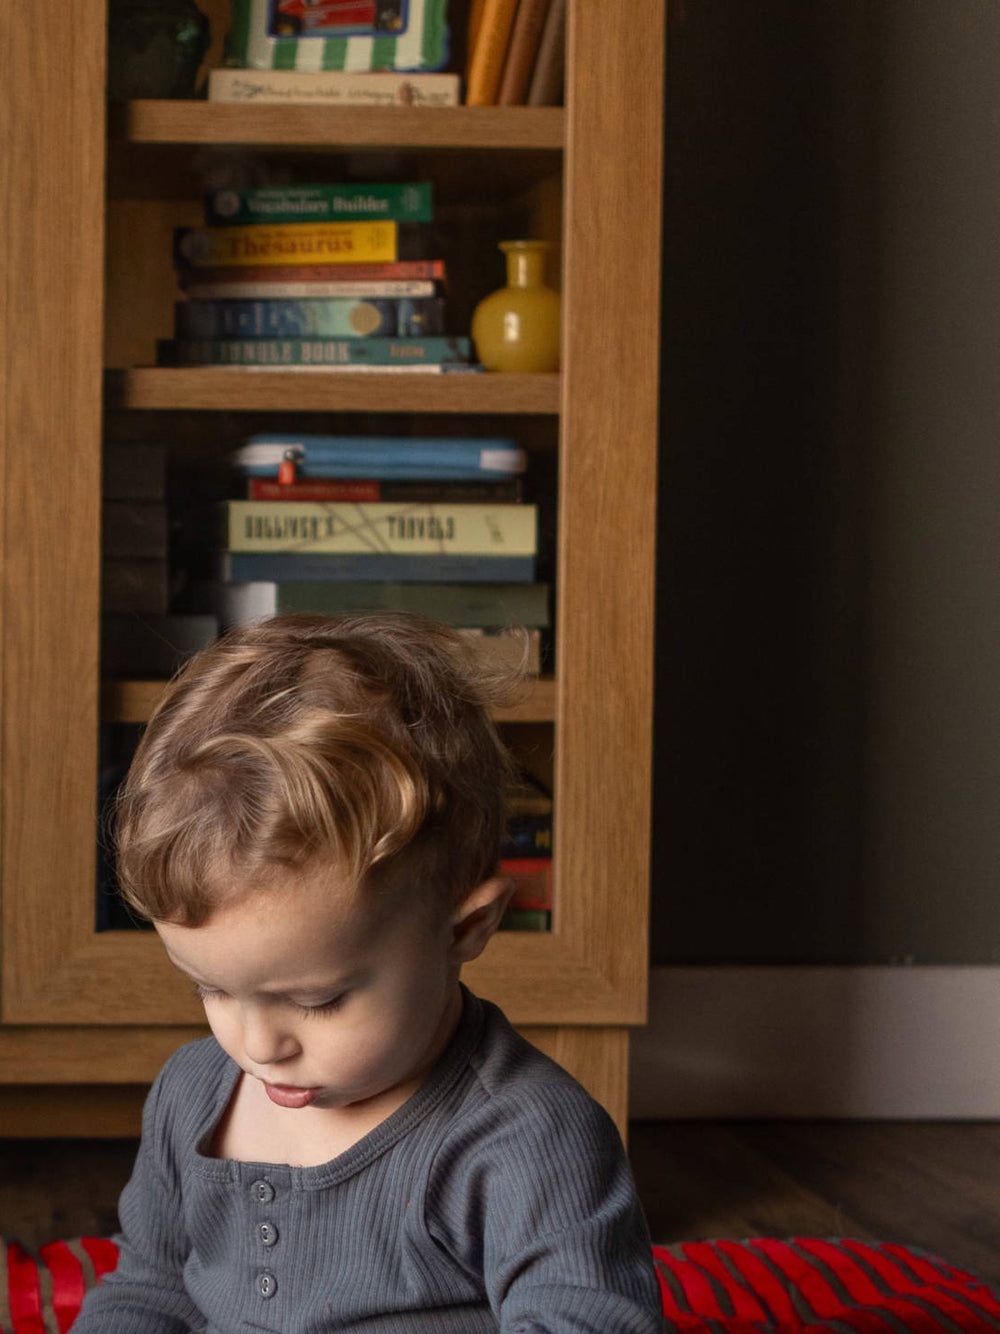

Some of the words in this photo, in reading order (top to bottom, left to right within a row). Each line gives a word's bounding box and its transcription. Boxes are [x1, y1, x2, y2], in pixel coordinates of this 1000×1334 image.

[247, 196, 328, 215] Vocabulary
[332, 196, 389, 213] Builder
[228, 236, 354, 257] Thesaurus
[300, 341, 350, 362] BOOK
